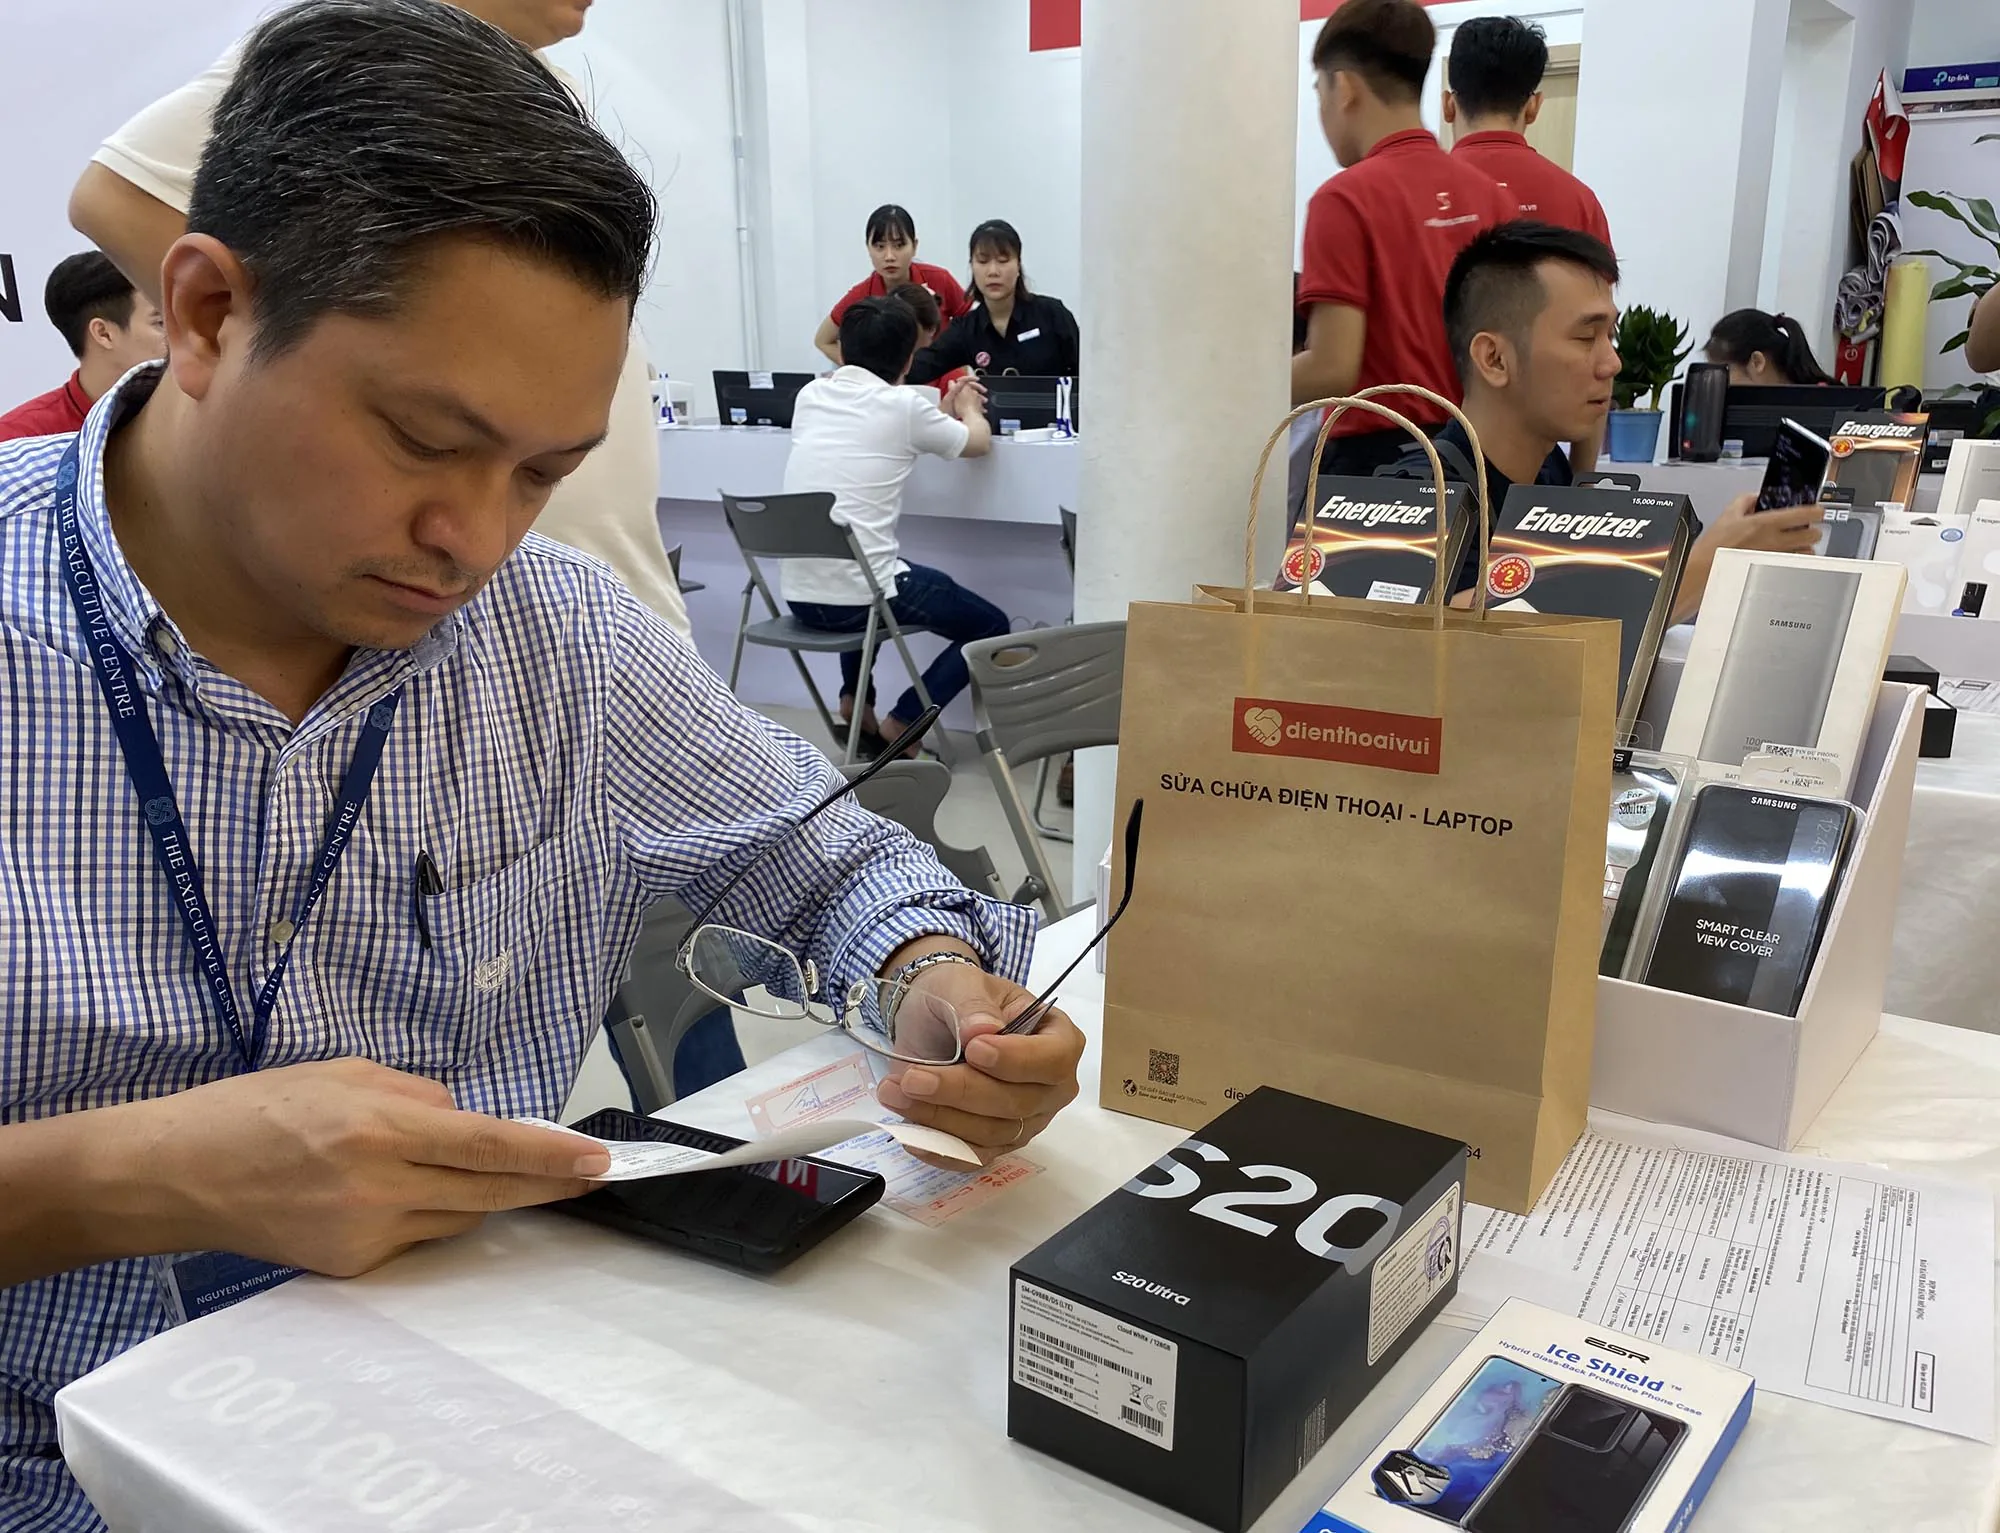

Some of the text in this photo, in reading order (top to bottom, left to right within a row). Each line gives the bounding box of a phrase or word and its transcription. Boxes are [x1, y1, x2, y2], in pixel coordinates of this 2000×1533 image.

[1316, 495, 1434, 528] Energizer
[1514, 506, 1652, 540] Energizer
[59, 493, 137, 720] THE EXECUTIVE CENTRE
[1769, 618, 1812, 630] SAMSUNG
[1285, 721, 1431, 756] dienthoaivui
[1160, 772, 1206, 795] SỬA
[1210, 780, 1273, 803] CHỮA
[1278, 788, 1329, 812] ĐIỆN
[1335, 795, 1403, 824] THOẠI
[1422, 807, 1514, 837] LAPTOP
[1751, 796, 1798, 810] SAMSUNG
[323, 799, 358, 869] CENTRE
[162, 830, 186, 870] THE
[175, 868, 221, 975] EXECUTIVE
[1696, 918, 1781, 945] SMART CLEAR
[1696, 933, 1774, 958] VIEW COVER
[1120, 1139, 1402, 1275] S20
[196, 1283, 240, 1305] NGUYEN
[242, 1273, 272, 1290] MINH
[1111, 1271, 1191, 1307] S20 Ultra
[1546, 1343, 1582, 1364] Ice
[1586, 1357, 1665, 1392] Shield
[1584, 1336, 1650, 1364] ESR
[1498, 1340, 1703, 1416] Hybrid Glass-Back Protective Phone Case
